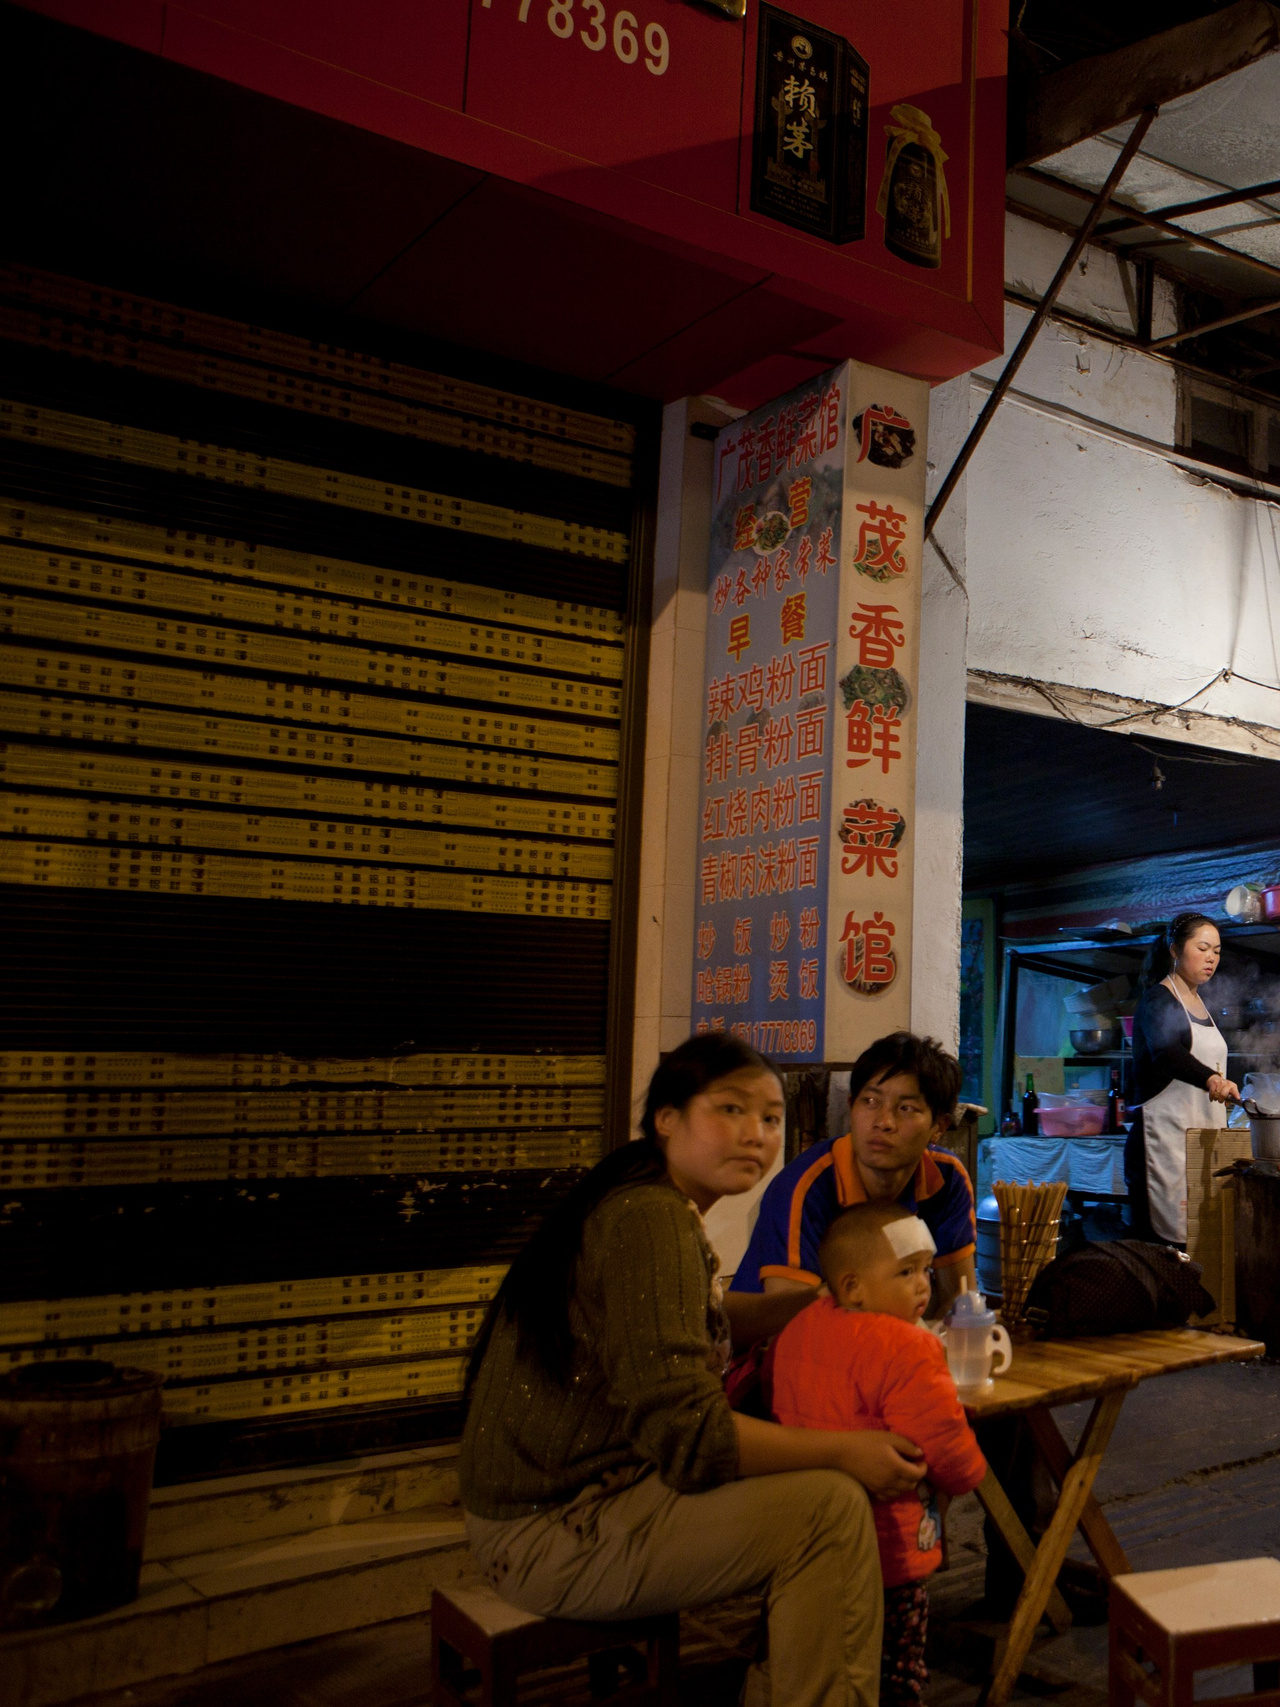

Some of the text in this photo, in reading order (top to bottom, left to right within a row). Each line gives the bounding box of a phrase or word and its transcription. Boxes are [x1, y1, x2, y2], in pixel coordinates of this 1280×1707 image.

[482, 0, 670, 76] 8369
[782, 74, 818, 160] 赖茅
[717, 381, 841, 501] 广茂香鲜菜馆
[712, 527, 837, 615] 炒各种家常菜
[707, 641, 828, 726] 辣鸡粉面
[839, 405, 910, 985] 广茂香鲜菜馆
[705, 705, 828, 786] 排骨粉面
[702, 770, 825, 844] 红烧肉粉面
[701, 835, 820, 905] 青椒肉沫粉面
[698, 907, 821, 961] 炒饭 炒粉
[770, 958, 820, 1002] 烫饭
